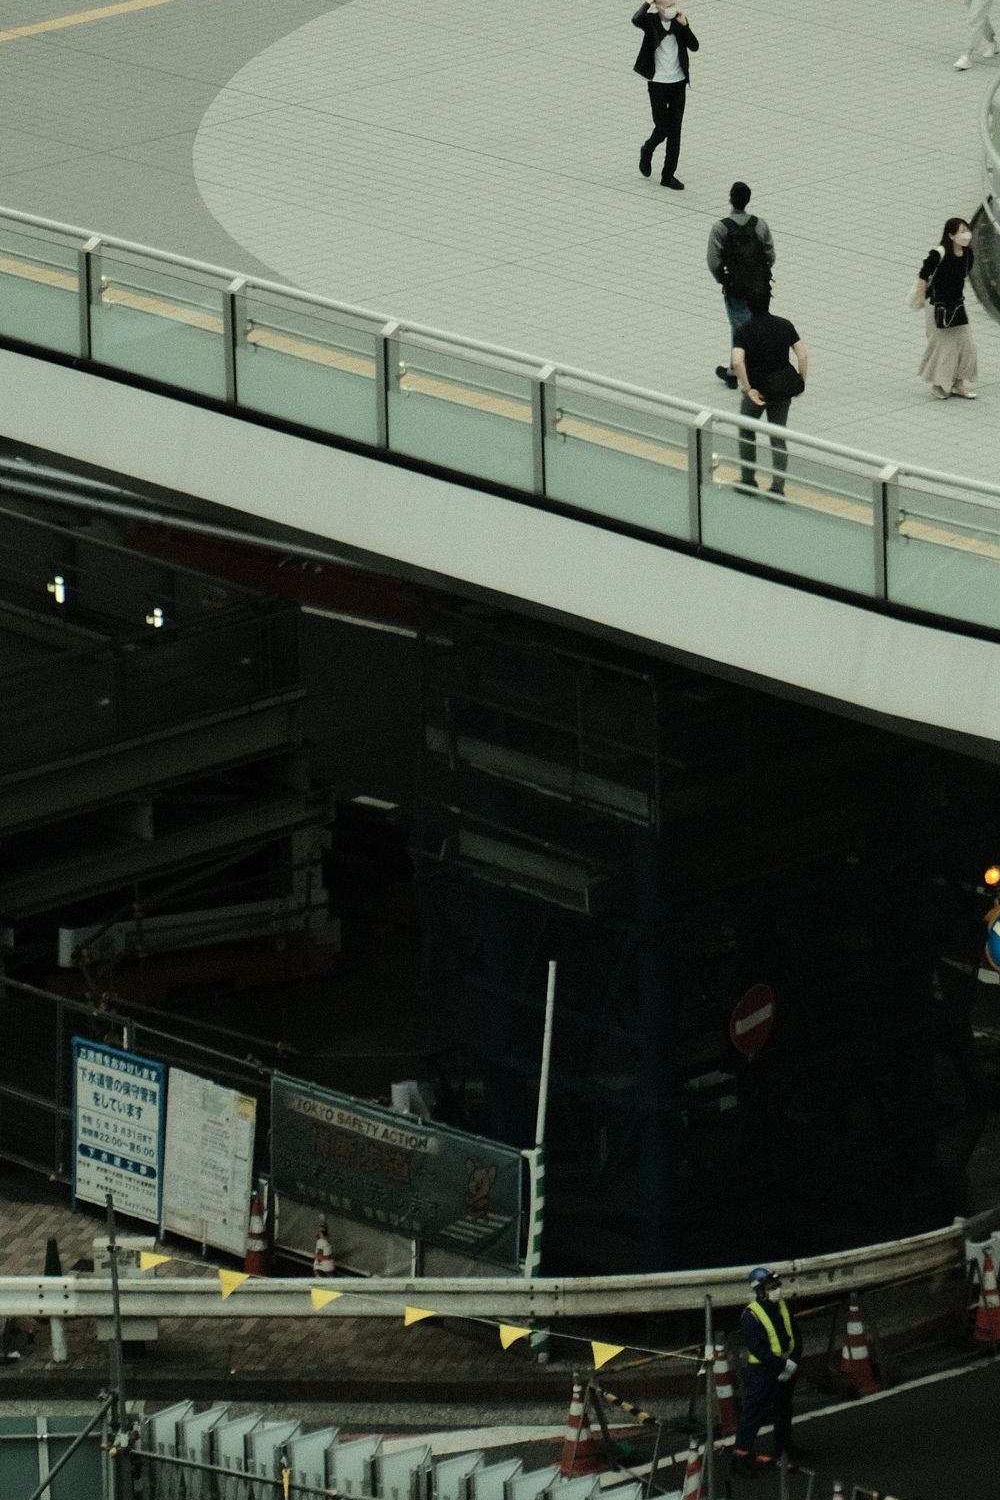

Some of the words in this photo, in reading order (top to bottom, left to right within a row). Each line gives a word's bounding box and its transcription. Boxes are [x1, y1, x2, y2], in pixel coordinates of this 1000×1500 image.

[79, 1066, 157, 1105] 下水道管の保守管理
[92, 1091, 144, 1120] をしています
[296, 1098, 334, 1122] TOKYO
[337, 1112, 380, 1137] SAFETY
[381, 1128, 428, 1150] ACTION
